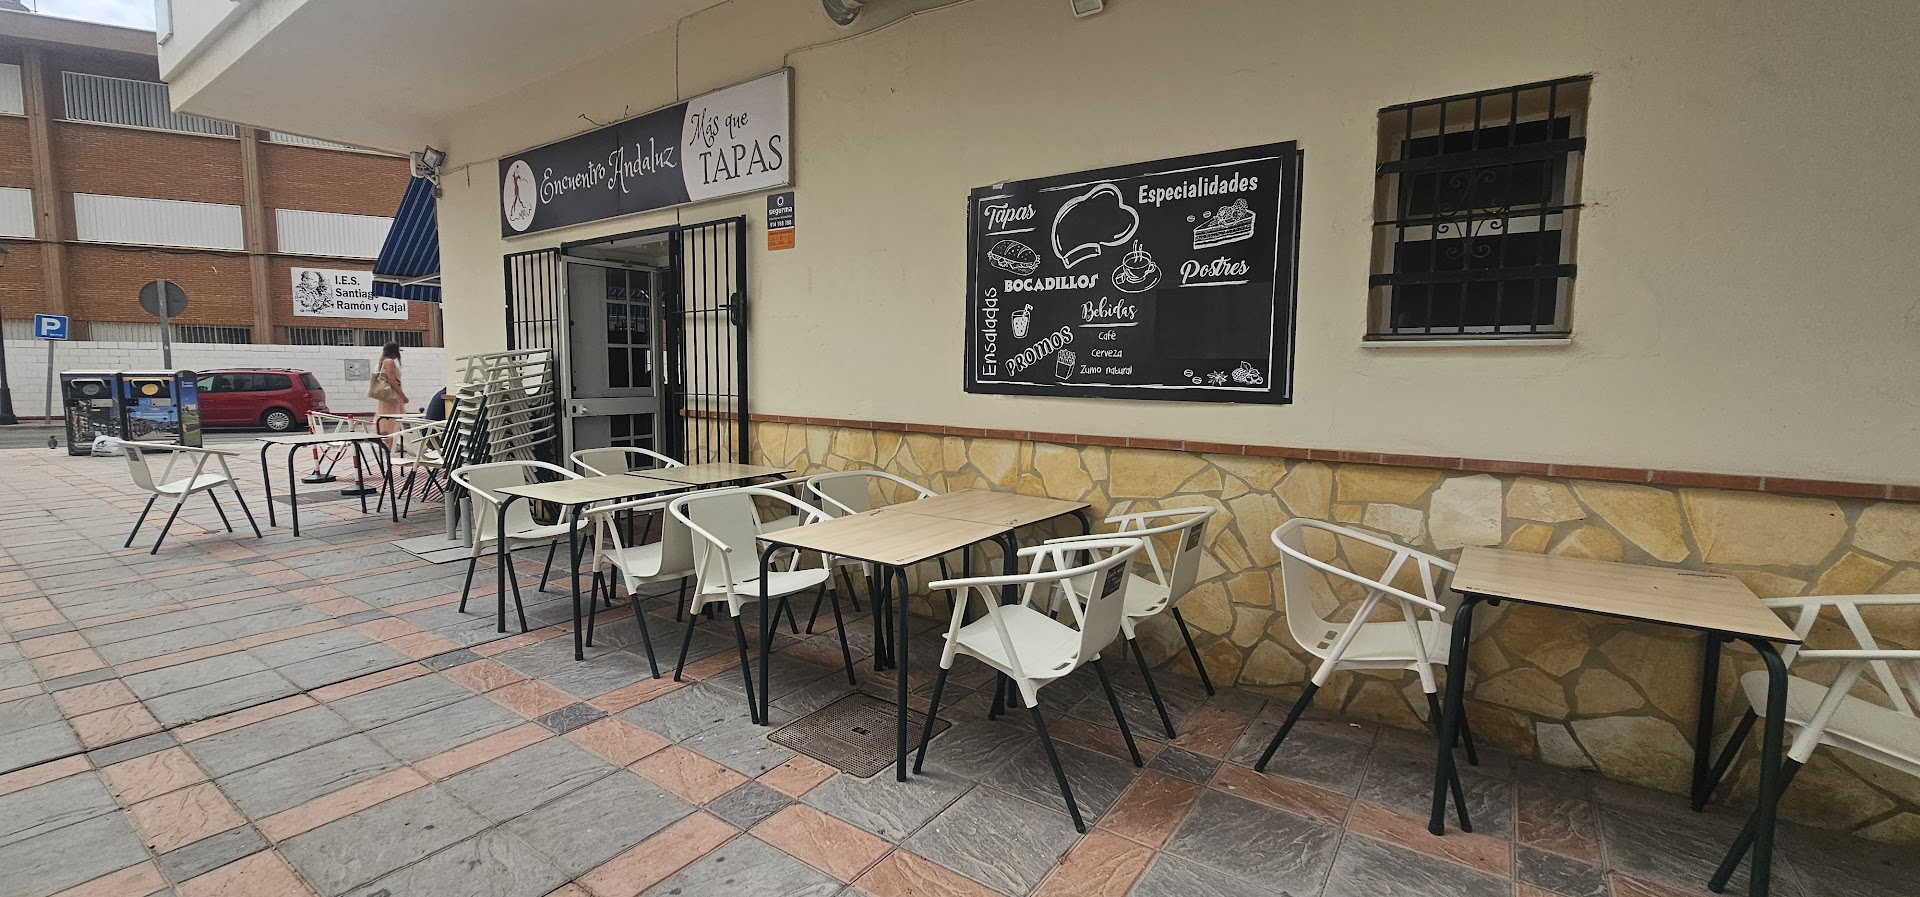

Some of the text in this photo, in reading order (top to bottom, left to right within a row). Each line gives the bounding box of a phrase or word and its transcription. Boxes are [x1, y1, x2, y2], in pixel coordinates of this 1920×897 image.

[690, 108, 749, 148] Más que
[540, 136, 678, 204] Encuentro Andaluz
[699, 135, 783, 185] TAPAS
[1138, 172, 1259, 207] Especialidades
[984, 202, 1037, 230] Tapas
[335, 275, 360, 285] I.E.S.
[1004, 273, 1099, 293] BOCADILLOS
[1180, 256, 1250, 284] Postres
[335, 288, 378, 300] Santiag
[336, 301, 406, 313] Ramón y Cajal
[1081, 296, 1138, 322] Bebidas
[41, 317, 61, 336] P
[981, 287, 999, 376] Ensaladas
[1098, 330, 1117, 341] Café
[1005, 326, 1074, 377] PROMOS
[1080, 365, 1133, 375] Zumo natural
